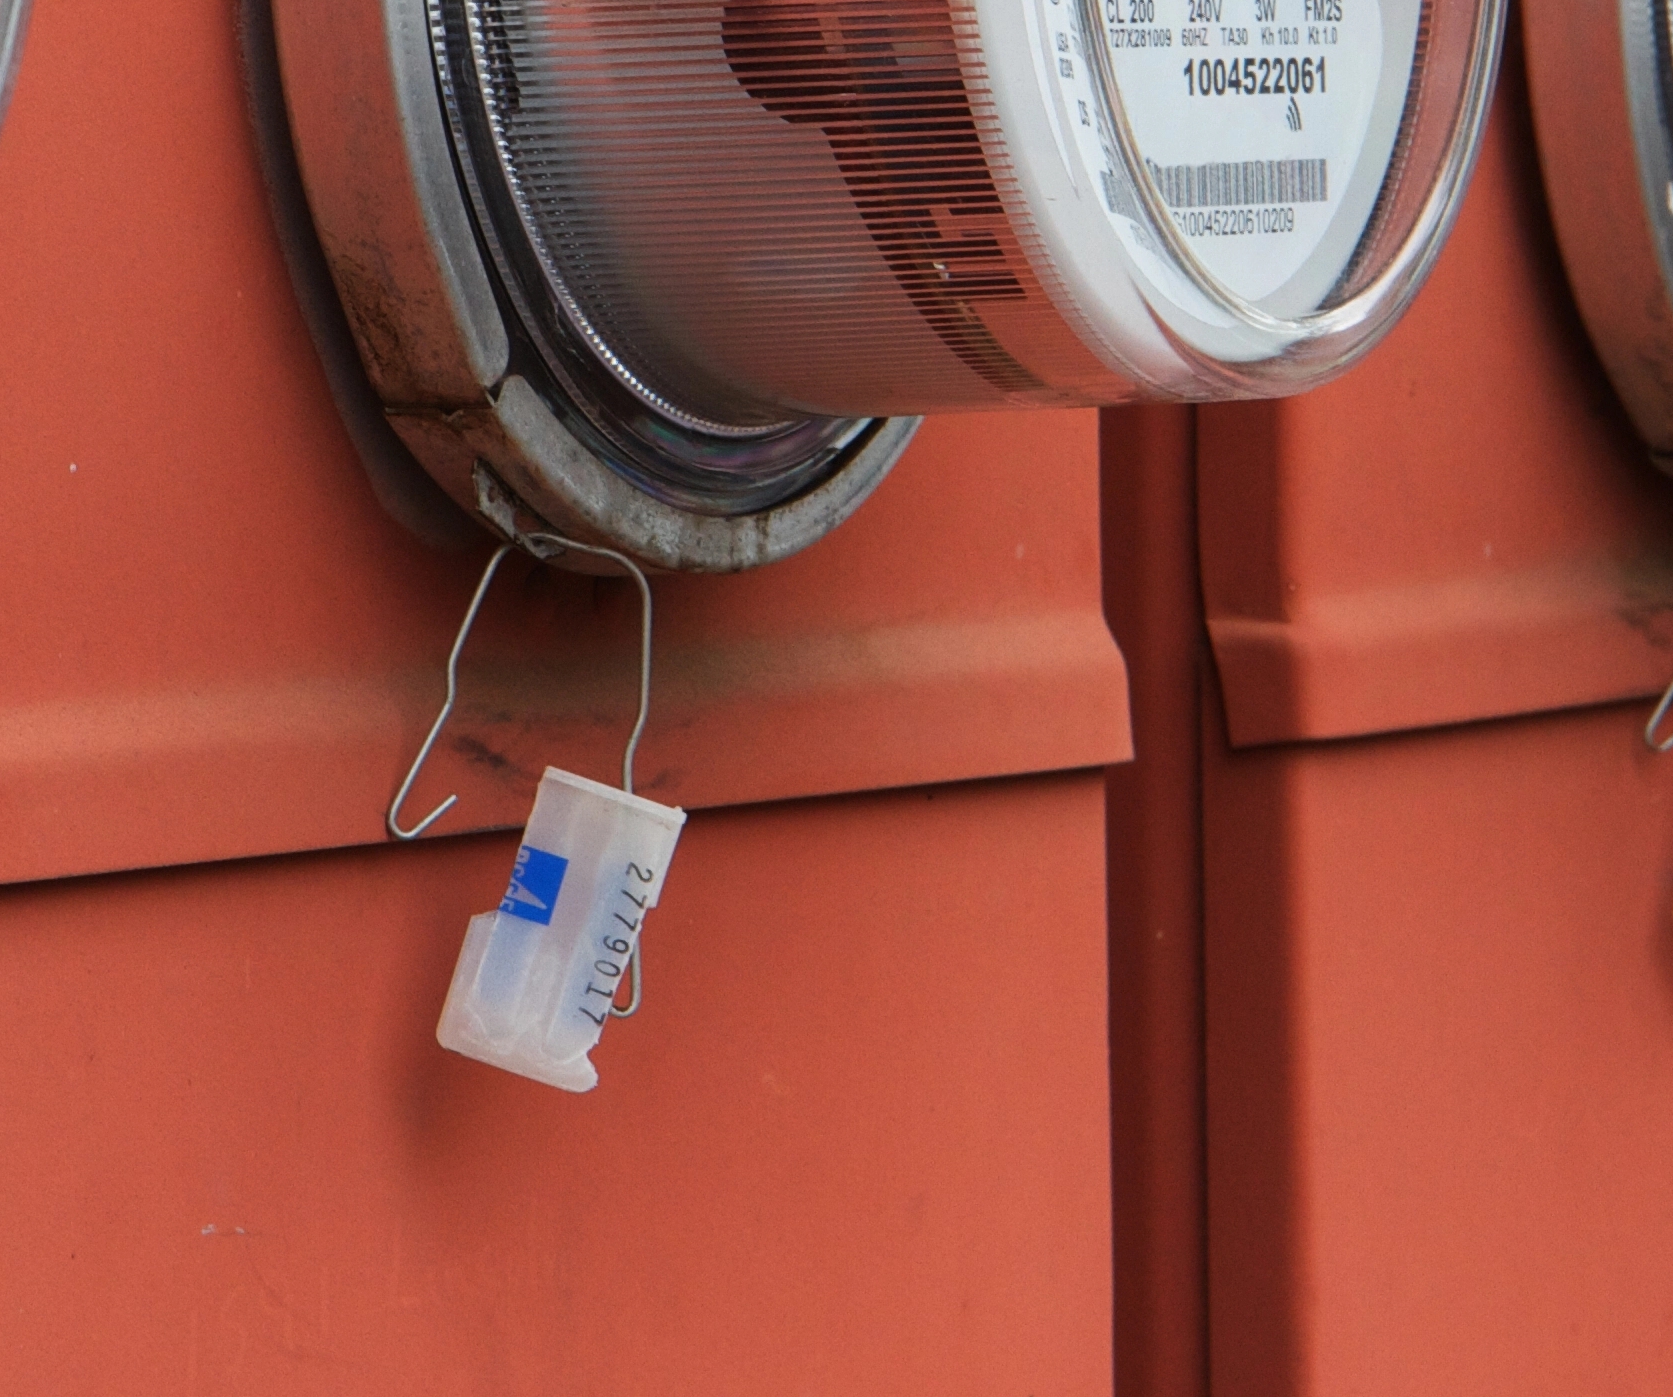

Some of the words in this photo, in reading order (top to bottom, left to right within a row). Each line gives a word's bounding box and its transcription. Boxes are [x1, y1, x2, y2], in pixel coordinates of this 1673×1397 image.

[1181, 27, 1209, 47] 60HZ
[1220, 27, 1249, 47] TA30
[1261, 26, 1275, 46] Kh
[1277, 26, 1299, 46] 10.0
[1322, 25, 1339, 45] 1.0
[1183, 55, 1327, 97] 1004522061
[578, 860, 654, 1029] 2779017
